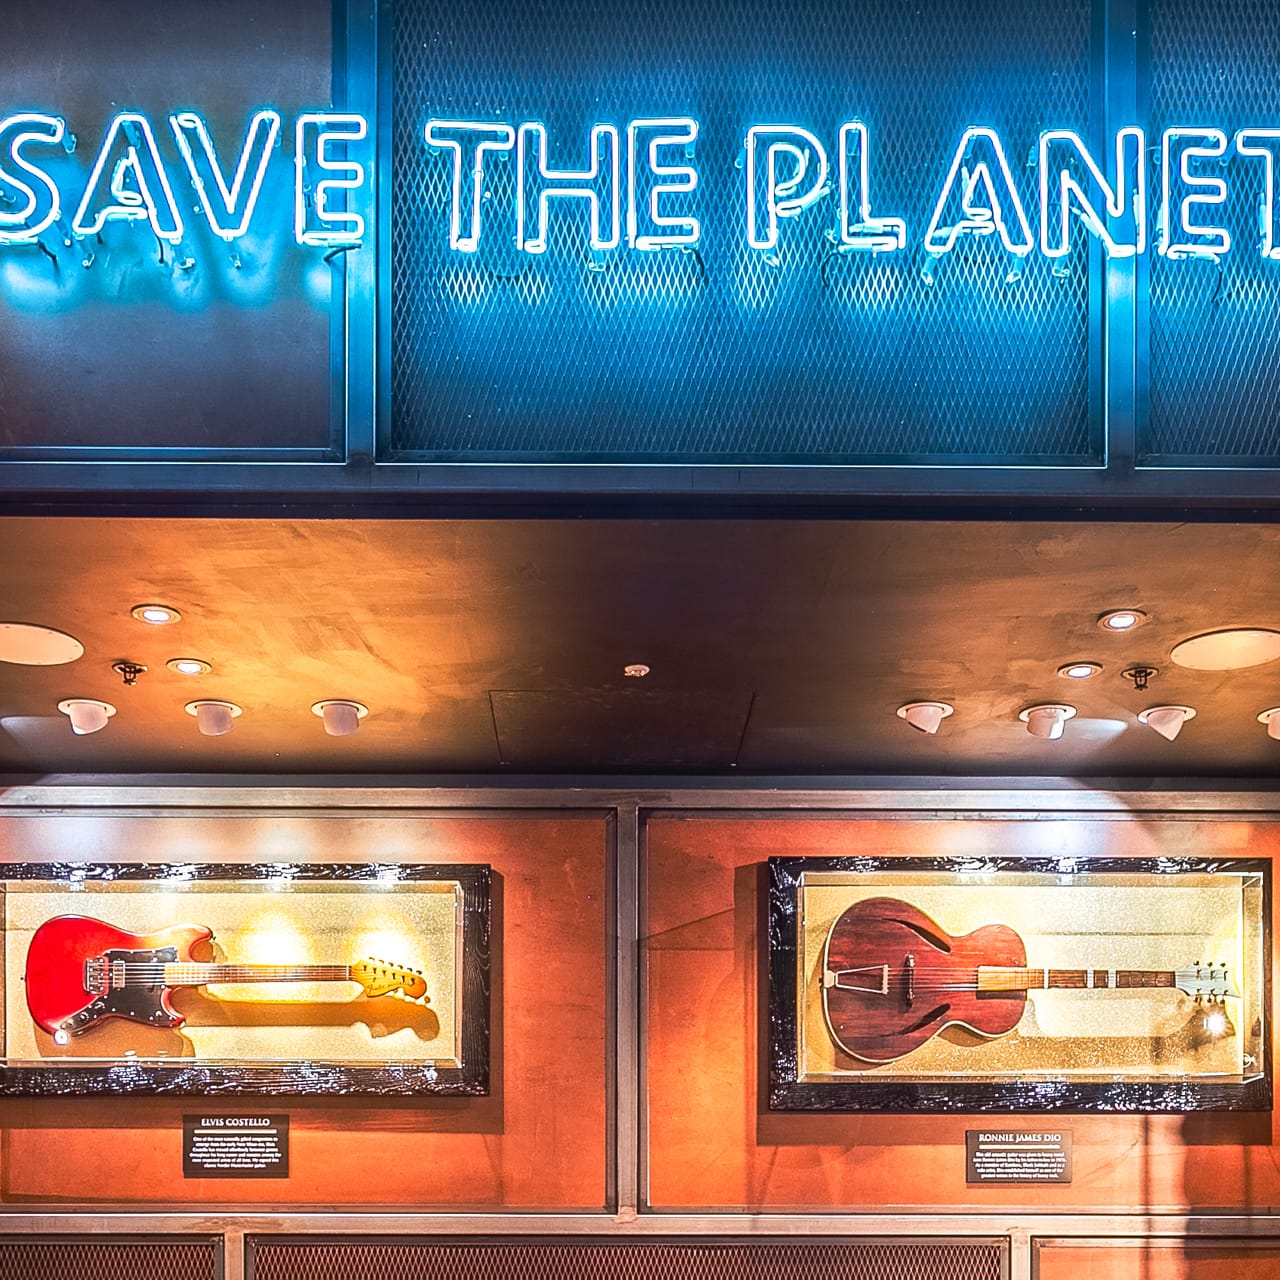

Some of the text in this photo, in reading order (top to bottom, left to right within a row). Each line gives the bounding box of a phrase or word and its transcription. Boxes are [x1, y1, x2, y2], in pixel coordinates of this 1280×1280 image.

[423, 118, 701, 253] THE
[201, 1118, 271, 1127] ELVIS COSTELLO
[978, 1133, 1062, 1143] RONNIE JAMES DIO
